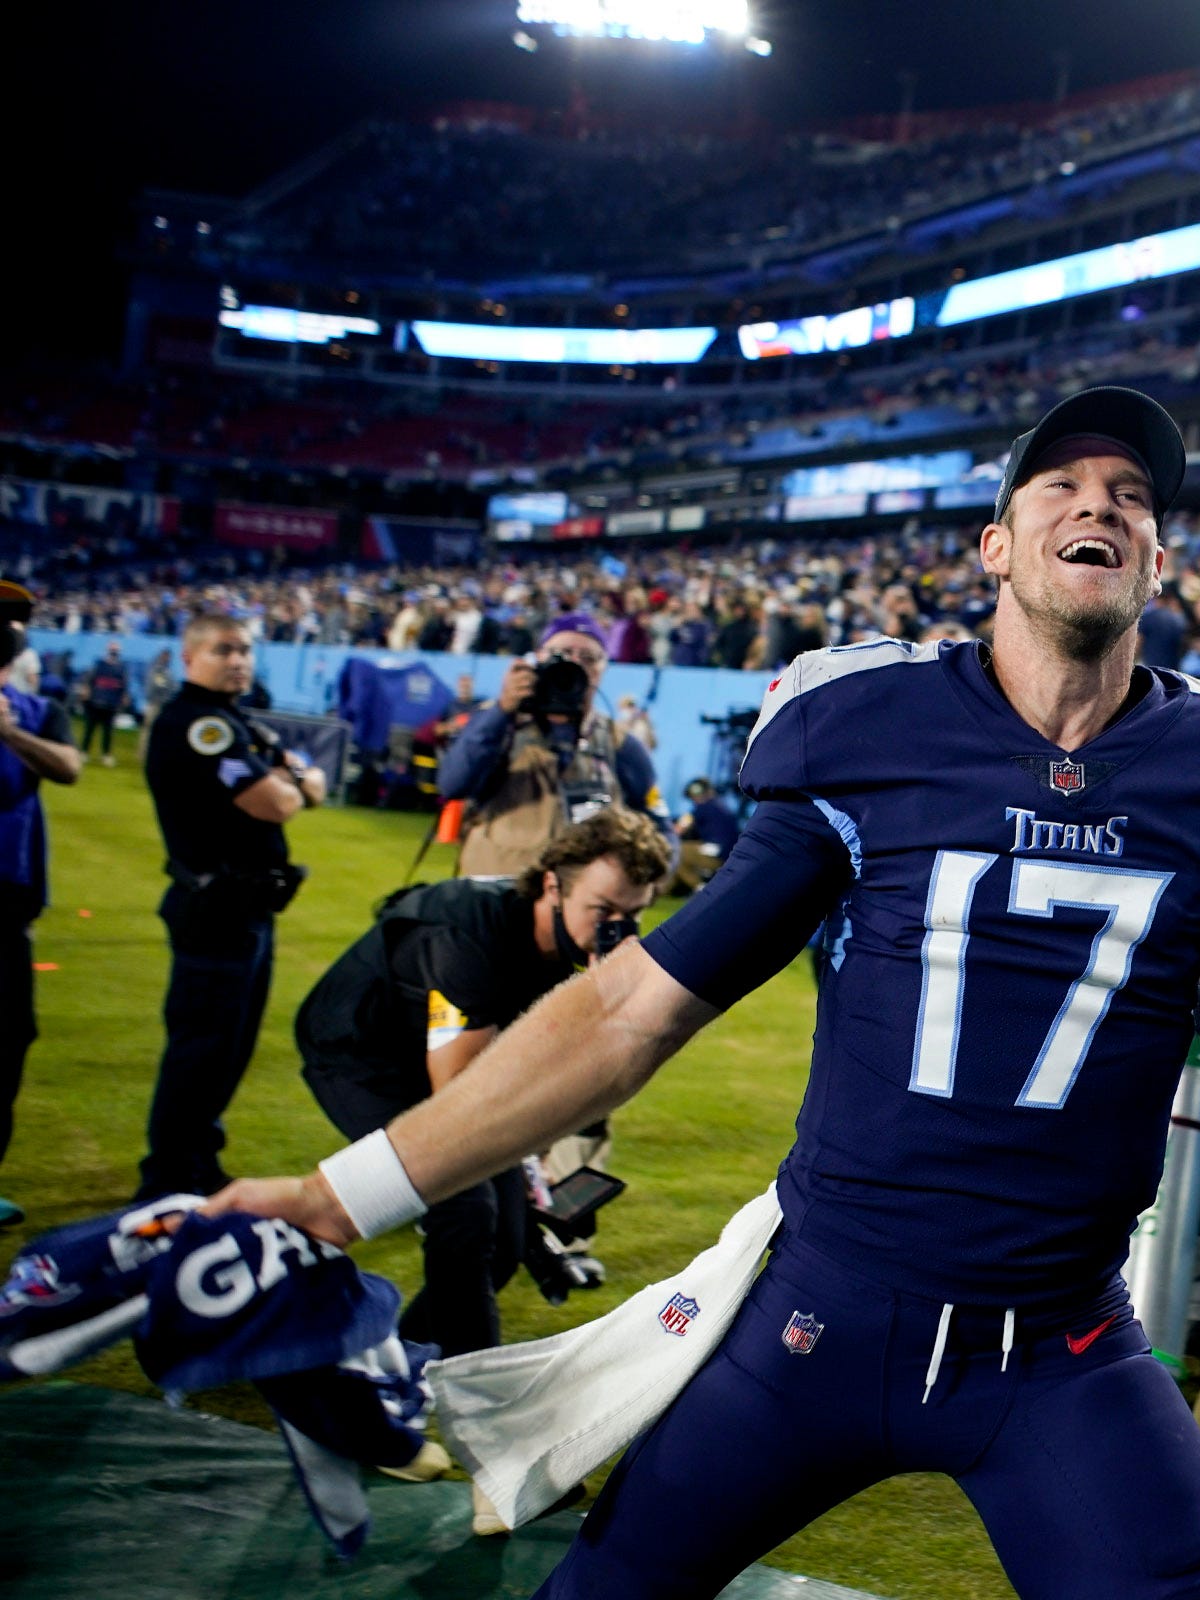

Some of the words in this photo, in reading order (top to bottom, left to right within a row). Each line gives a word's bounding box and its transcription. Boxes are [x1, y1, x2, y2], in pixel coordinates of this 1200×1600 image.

[1054, 772, 1081, 788] NFL
[1005, 806, 1128, 857] TITANS
[908, 849, 1176, 1110] 17
[175, 1217, 346, 1319] GA
[659, 1303, 690, 1335] NFL
[785, 1326, 815, 1350] NFL
